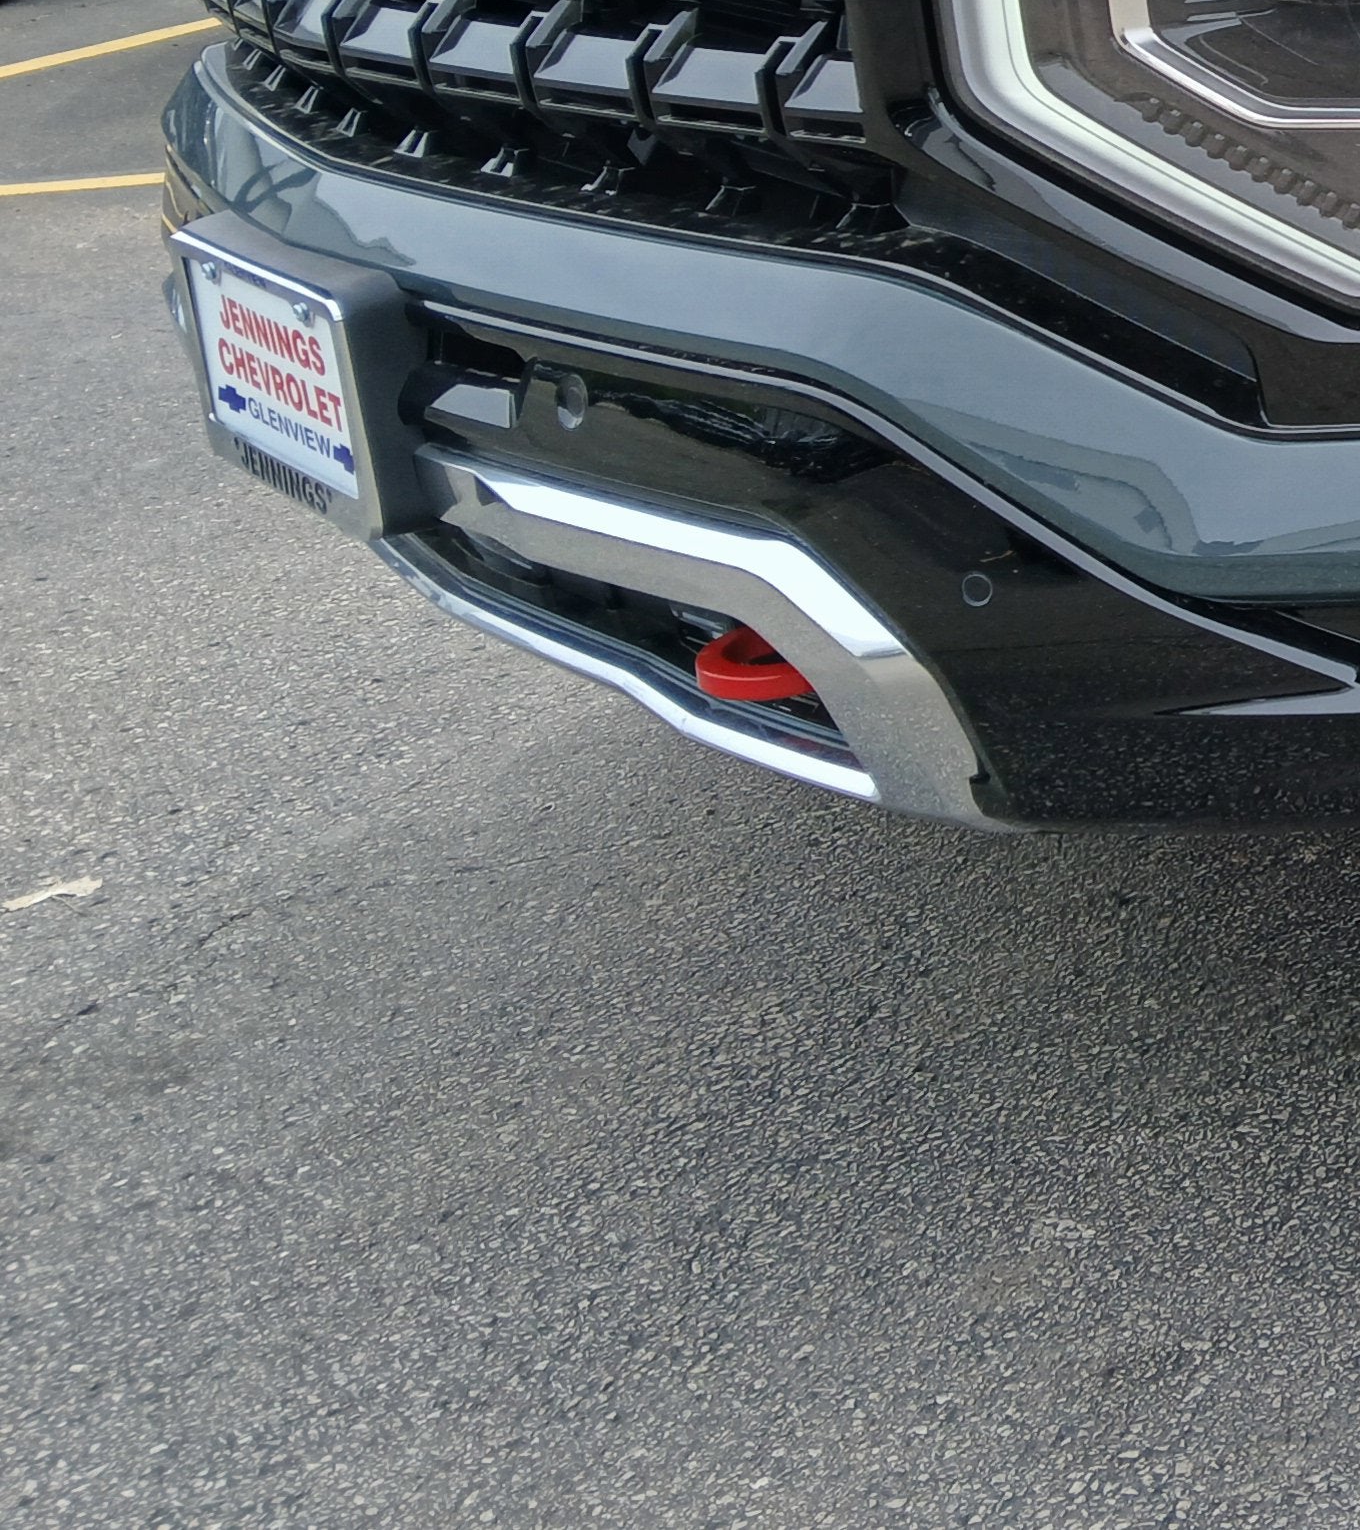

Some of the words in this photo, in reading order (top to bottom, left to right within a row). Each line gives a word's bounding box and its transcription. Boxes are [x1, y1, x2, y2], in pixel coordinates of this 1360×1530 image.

[219, 294, 326, 376] JENNINGS
[217, 337, 343, 432] CHEVROLET
[247, 396, 331, 459] GLENVIEW
